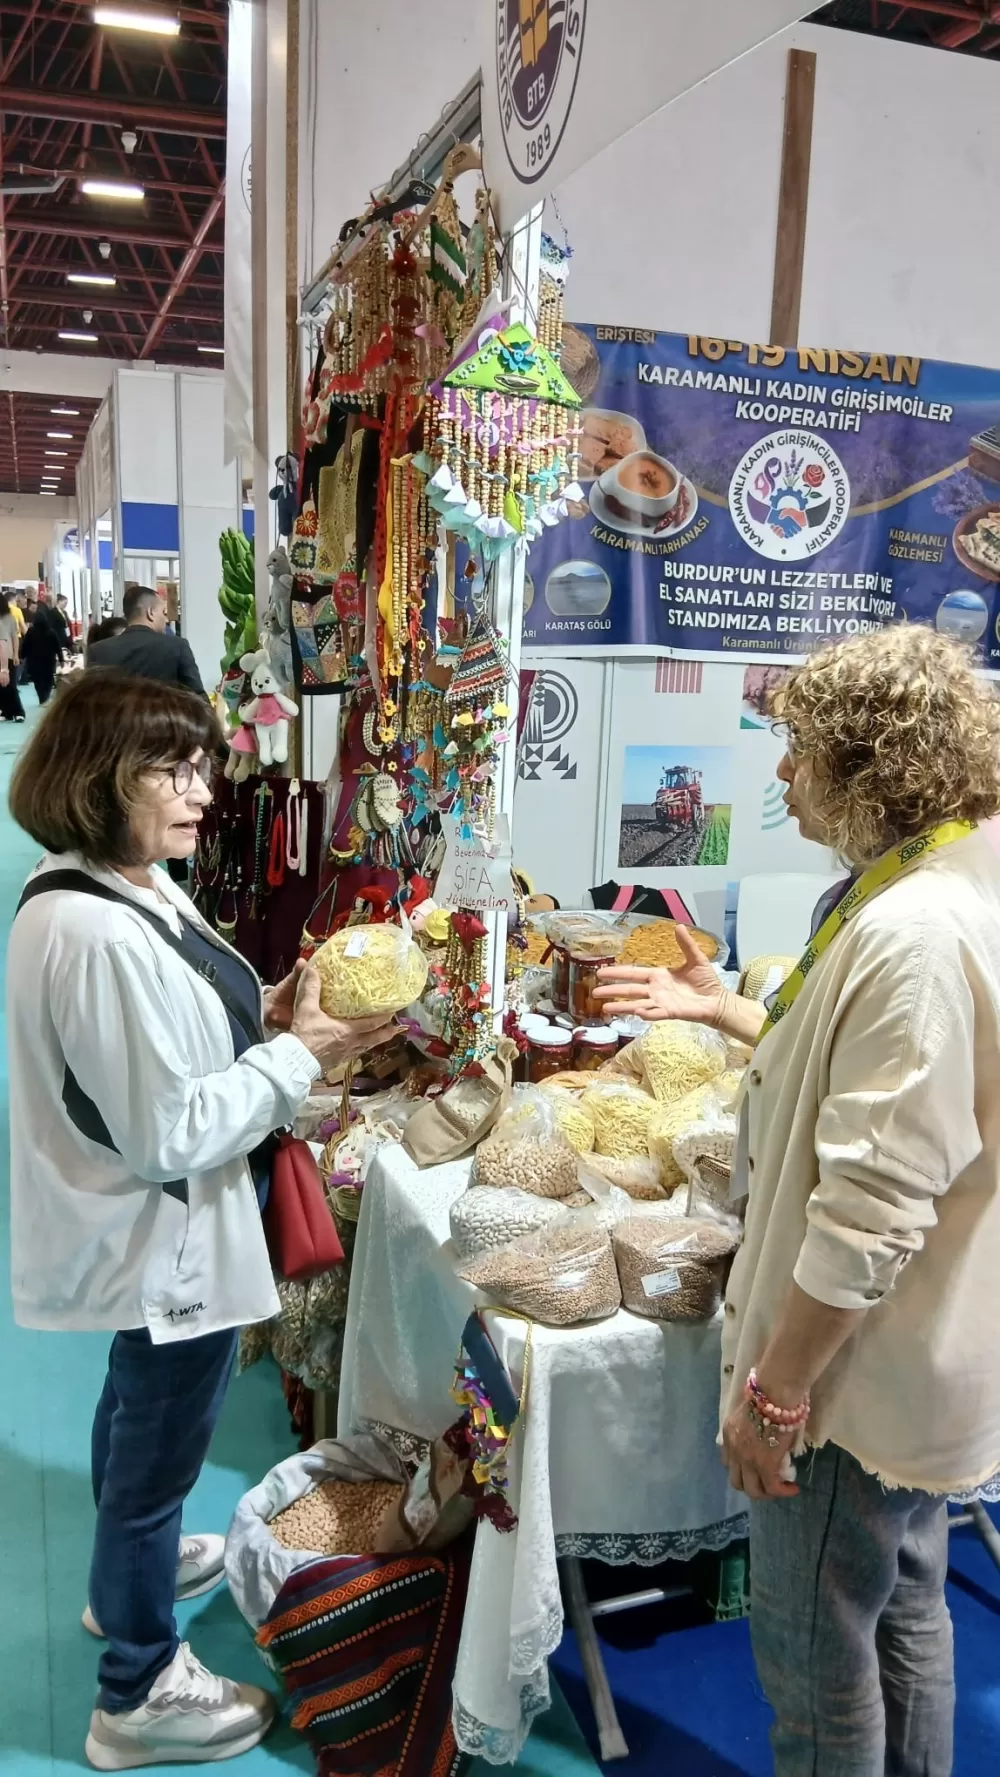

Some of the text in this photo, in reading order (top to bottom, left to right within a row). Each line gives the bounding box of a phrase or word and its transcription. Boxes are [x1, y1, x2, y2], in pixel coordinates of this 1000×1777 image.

[527, 72, 546, 114] BTB
[526, 123, 550, 167] 1989
[638, 362, 760, 396] KARAMANLI
[766, 379, 827, 405] KADIN
[735, 400, 861, 433] KOOPERATİFİ
[733, 432, 846, 554] KARAMANLI KADIN GİRİŞİMCİLER KOOPERATİFİ
[589, 515, 710, 555] KARAMANLI TARHANASI
[889, 528, 948, 548] KARAMANLI
[888, 544, 944, 563] GÖZLEMESİ
[770, 569, 879, 591] LEZZETLERİ
[880, 576, 893, 594] VE
[659, 583, 897, 617] EL SANATLARI SİZİ BEKLİYOR!
[545, 619, 612, 631] KARATAŞ GÖLÜ
[668, 608, 772, 632] STANDIMIZA
[722, 635, 781, 649] Karamanlı
[899, 834, 934, 865] YOREX
[797, 947, 818, 978] YOREX
